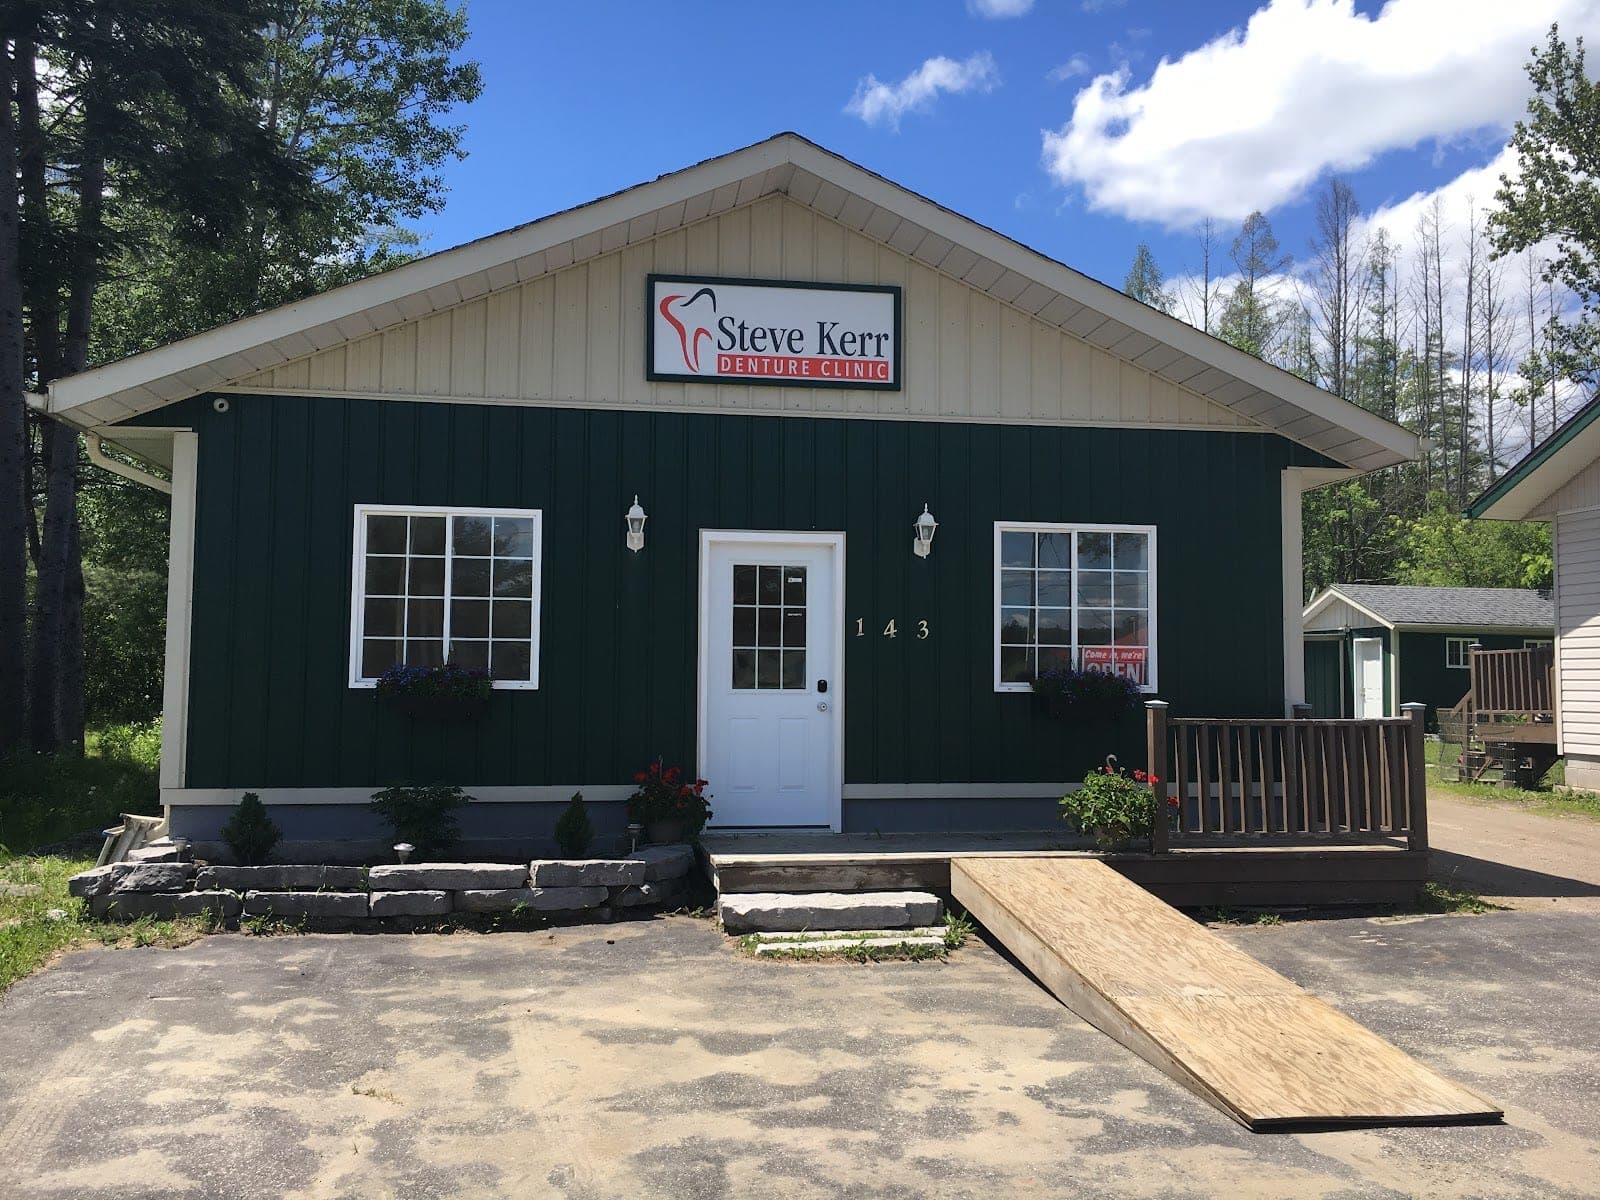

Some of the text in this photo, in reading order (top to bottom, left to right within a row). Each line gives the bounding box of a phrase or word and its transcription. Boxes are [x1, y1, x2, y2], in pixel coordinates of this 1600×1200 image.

[717, 316, 889, 358] Steve Kerr
[721, 356, 887, 379] DENTURE CLINIC
[1085, 649, 1107, 659] Come
[1121, 650, 1142, 660] we're
